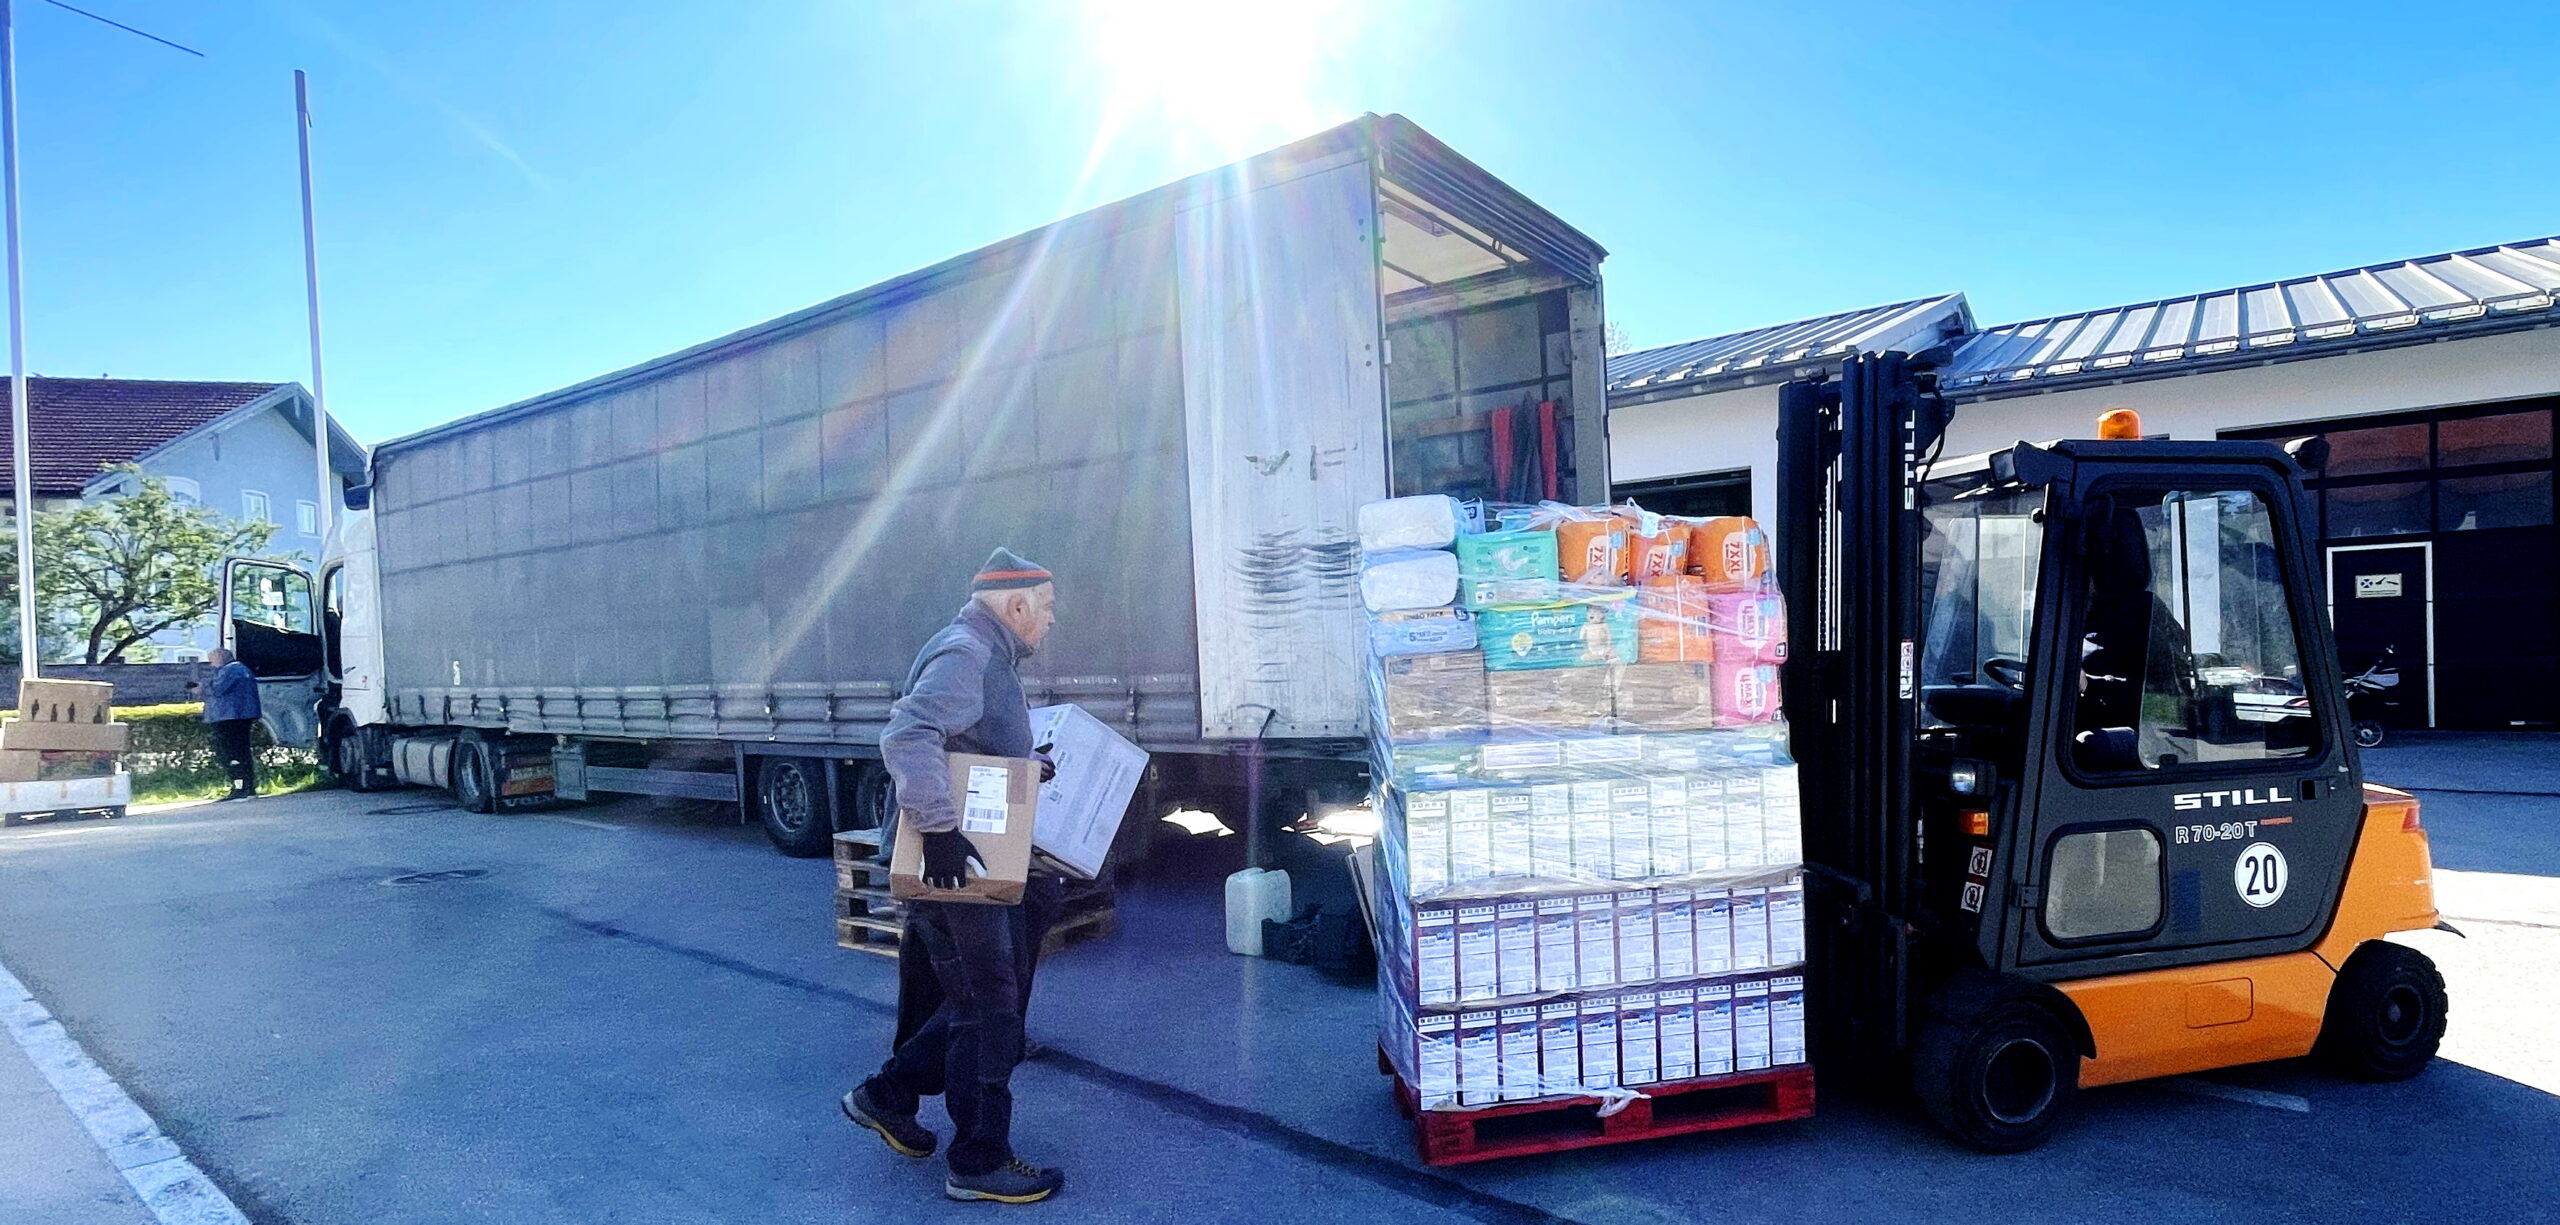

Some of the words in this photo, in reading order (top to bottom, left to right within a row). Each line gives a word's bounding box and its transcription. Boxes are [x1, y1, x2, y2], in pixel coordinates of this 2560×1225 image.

[1904, 409, 1915, 510] STILL
[1651, 553, 1664, 577] 7XX
[1730, 541, 1741, 574] 7XXL
[1530, 611, 1576, 627] Pampers
[2174, 787, 2292, 810] STILL
[2245, 854, 2278, 896] 20
